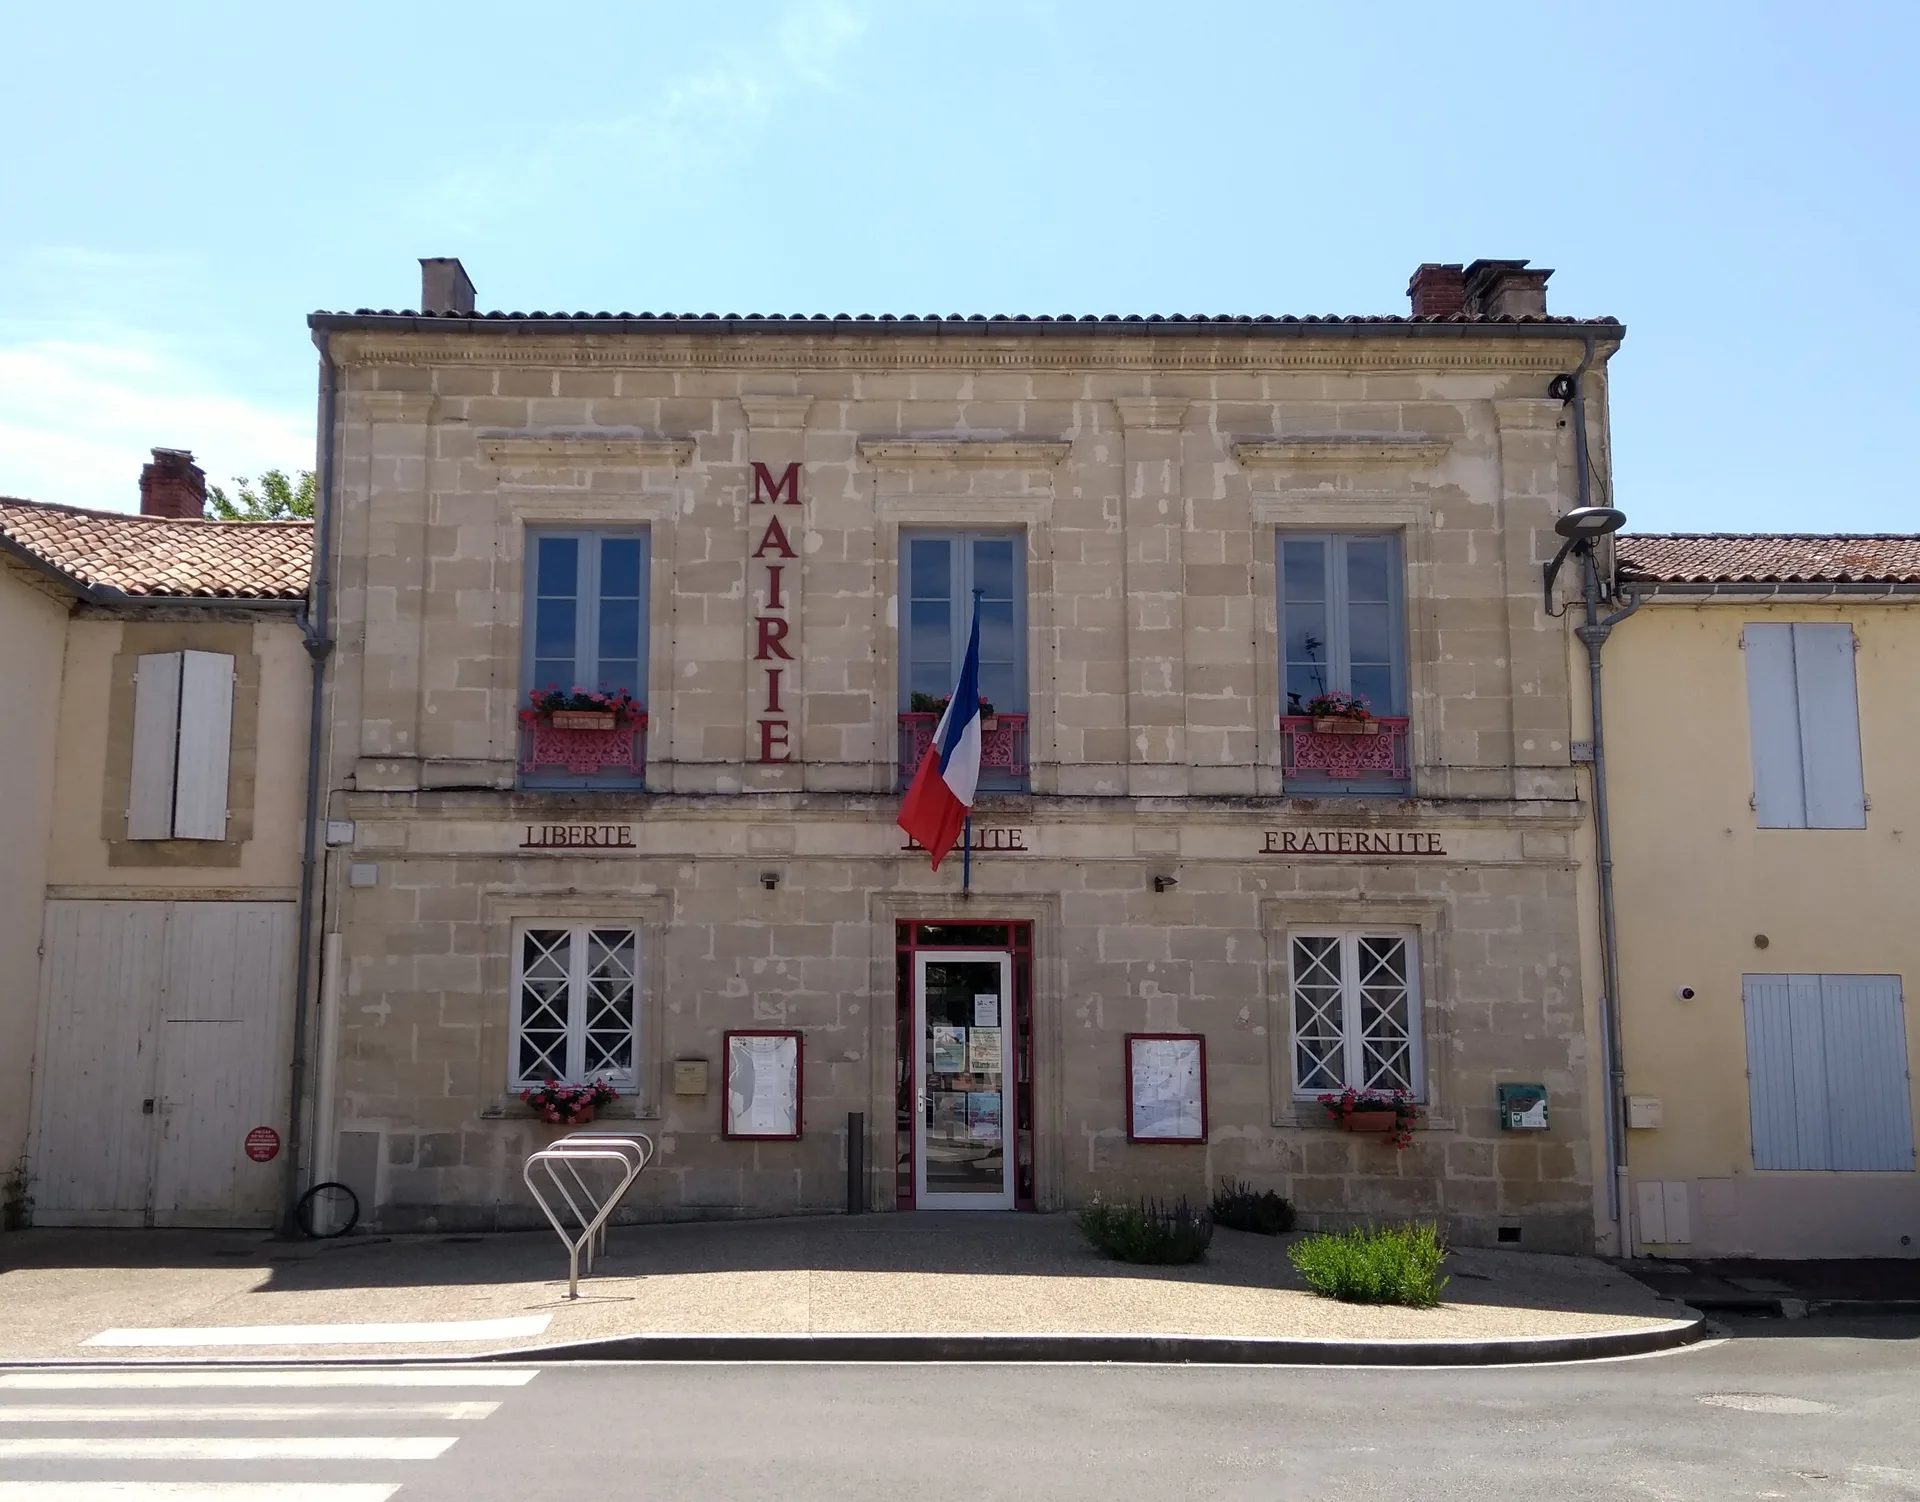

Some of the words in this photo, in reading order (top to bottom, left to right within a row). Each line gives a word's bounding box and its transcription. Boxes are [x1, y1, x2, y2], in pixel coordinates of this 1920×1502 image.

[750, 462, 803, 764] MAIRIE
[525, 825, 632, 847] LIBERTE
[907, 828, 1024, 850] ELITE
[1264, 831, 1443, 853] FRATERNITE
